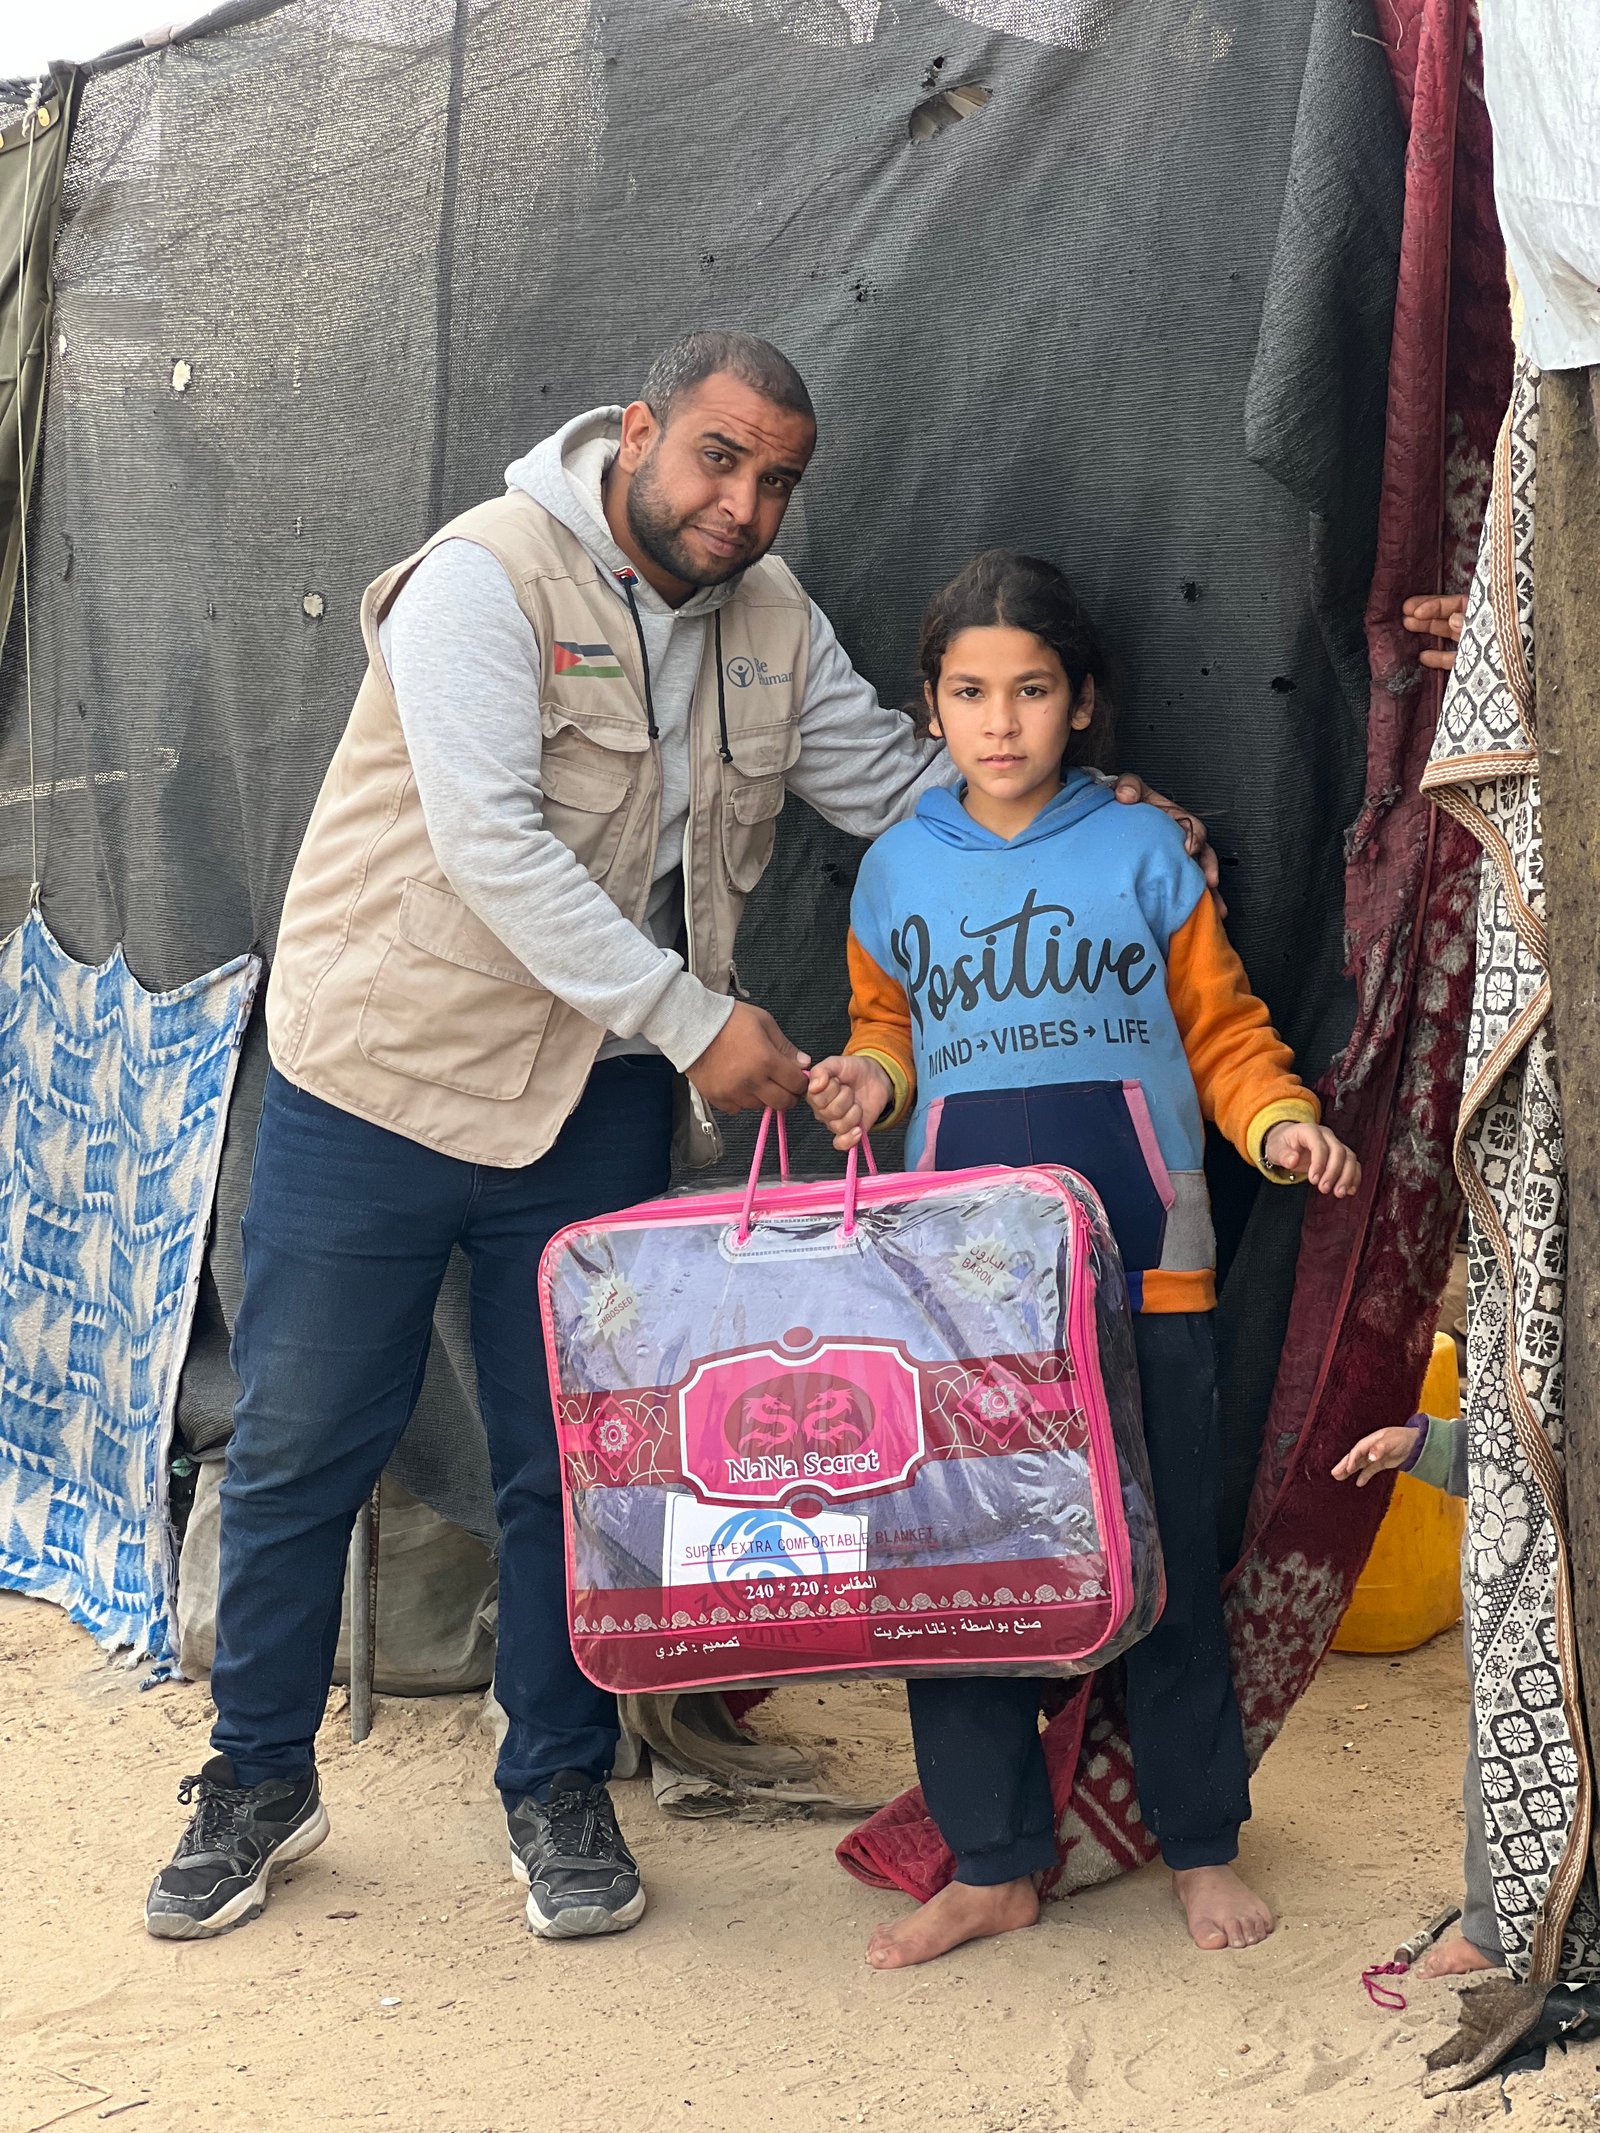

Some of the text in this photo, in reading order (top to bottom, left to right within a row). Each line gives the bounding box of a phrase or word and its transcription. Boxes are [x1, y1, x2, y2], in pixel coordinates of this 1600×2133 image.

[891, 888, 1157, 1050] Positive
[928, 1018, 1151, 1079] MIND VIBES LIFE
[961, 1257, 995, 1287] BARON
[597, 1296, 633, 1329] EMBOSSED
[725, 1449, 880, 1483] NaNa Secret
[685, 1526, 934, 1560] SUPER EXTRA COMFORTABLE BLANKET
[745, 1583, 774, 1600] 240
[791, 1581, 819, 1597] 220
[833, 1575, 877, 1595] المقاس
[873, 1624, 923, 1640] سيكريت
[924, 1621, 947, 1634] نانا
[960, 1617, 1009, 1633] بواسطة
[1013, 1617, 1042, 1635] صنع
[655, 1640, 688, 1660] كوري
[702, 1635, 740, 1655] تصميم
